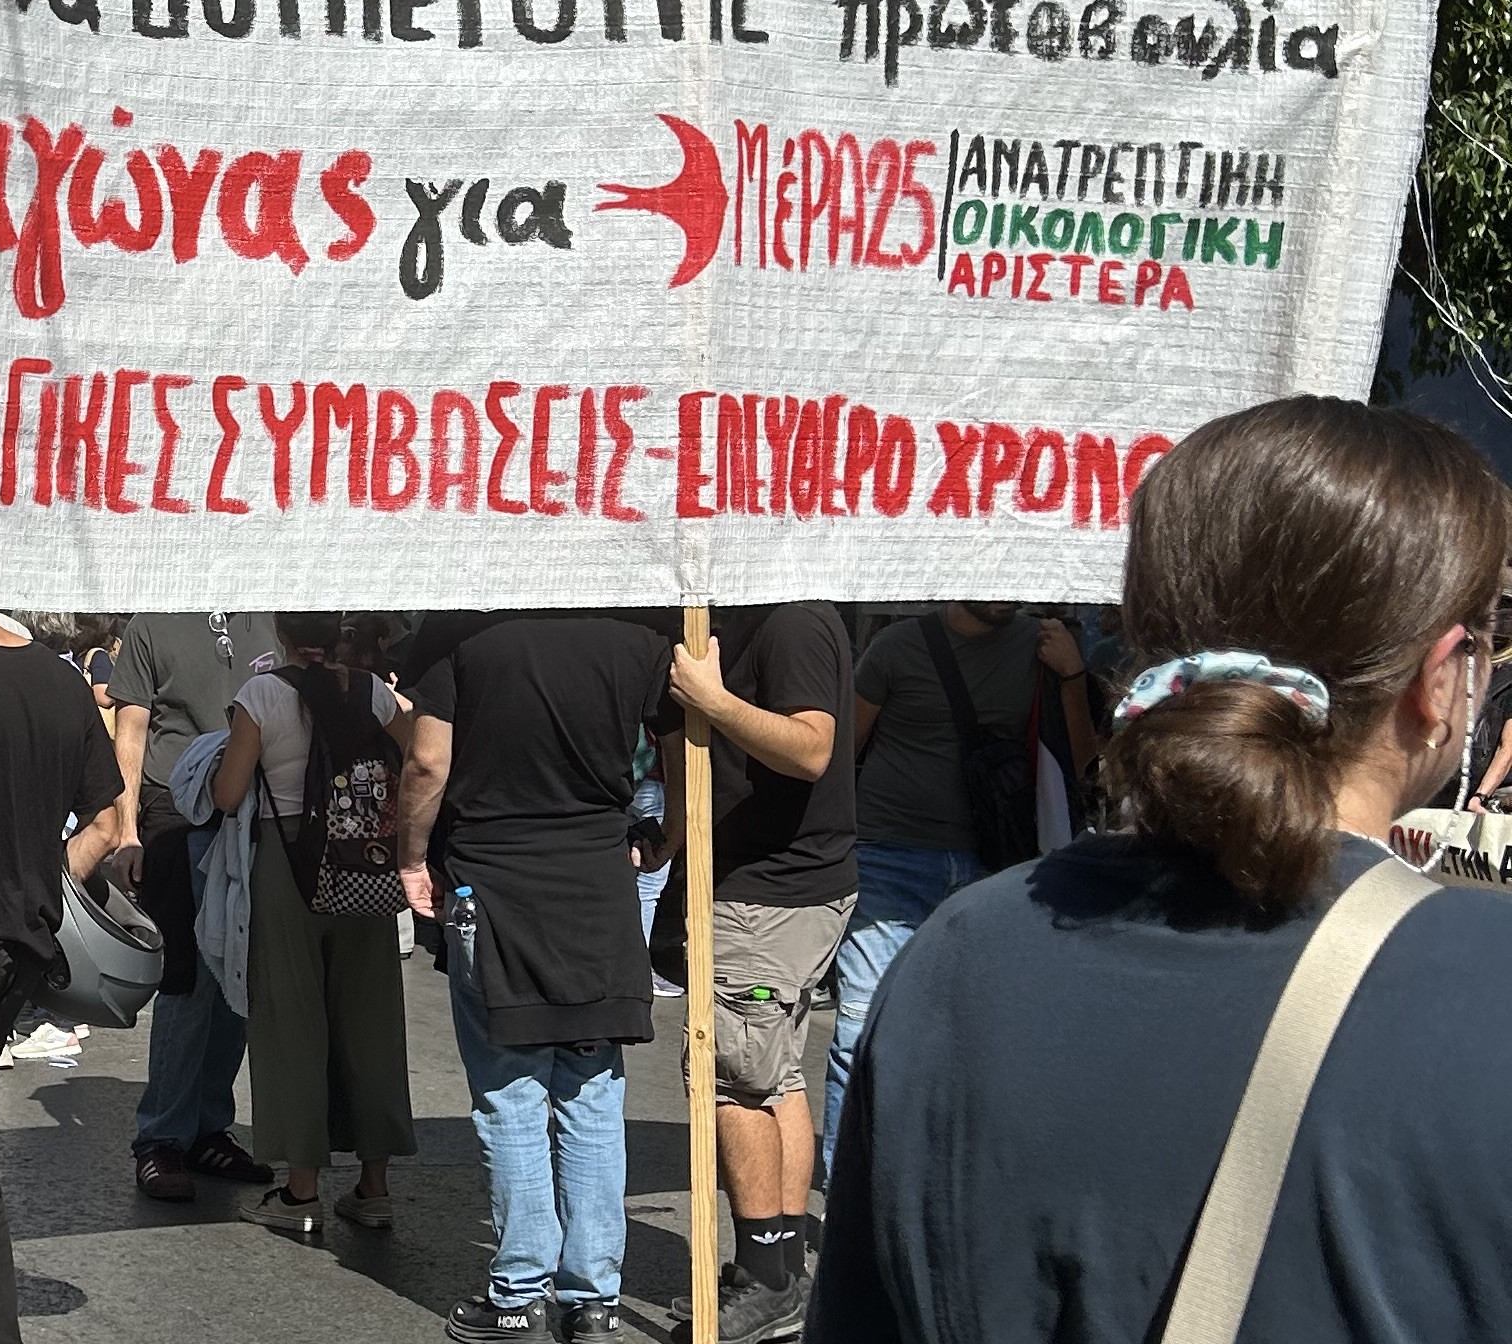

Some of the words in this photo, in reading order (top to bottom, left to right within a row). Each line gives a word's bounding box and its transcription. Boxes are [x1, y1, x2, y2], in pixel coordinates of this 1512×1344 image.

[399, 177, 572, 301] για
[953, 199, 1286, 269] ΟΙΚΟΛΟΓΙΚΗ
[947, 252, 1195, 312] ΑΡΙΣΤΕΡΑ
[497, 1315, 529, 1329] HOKA
